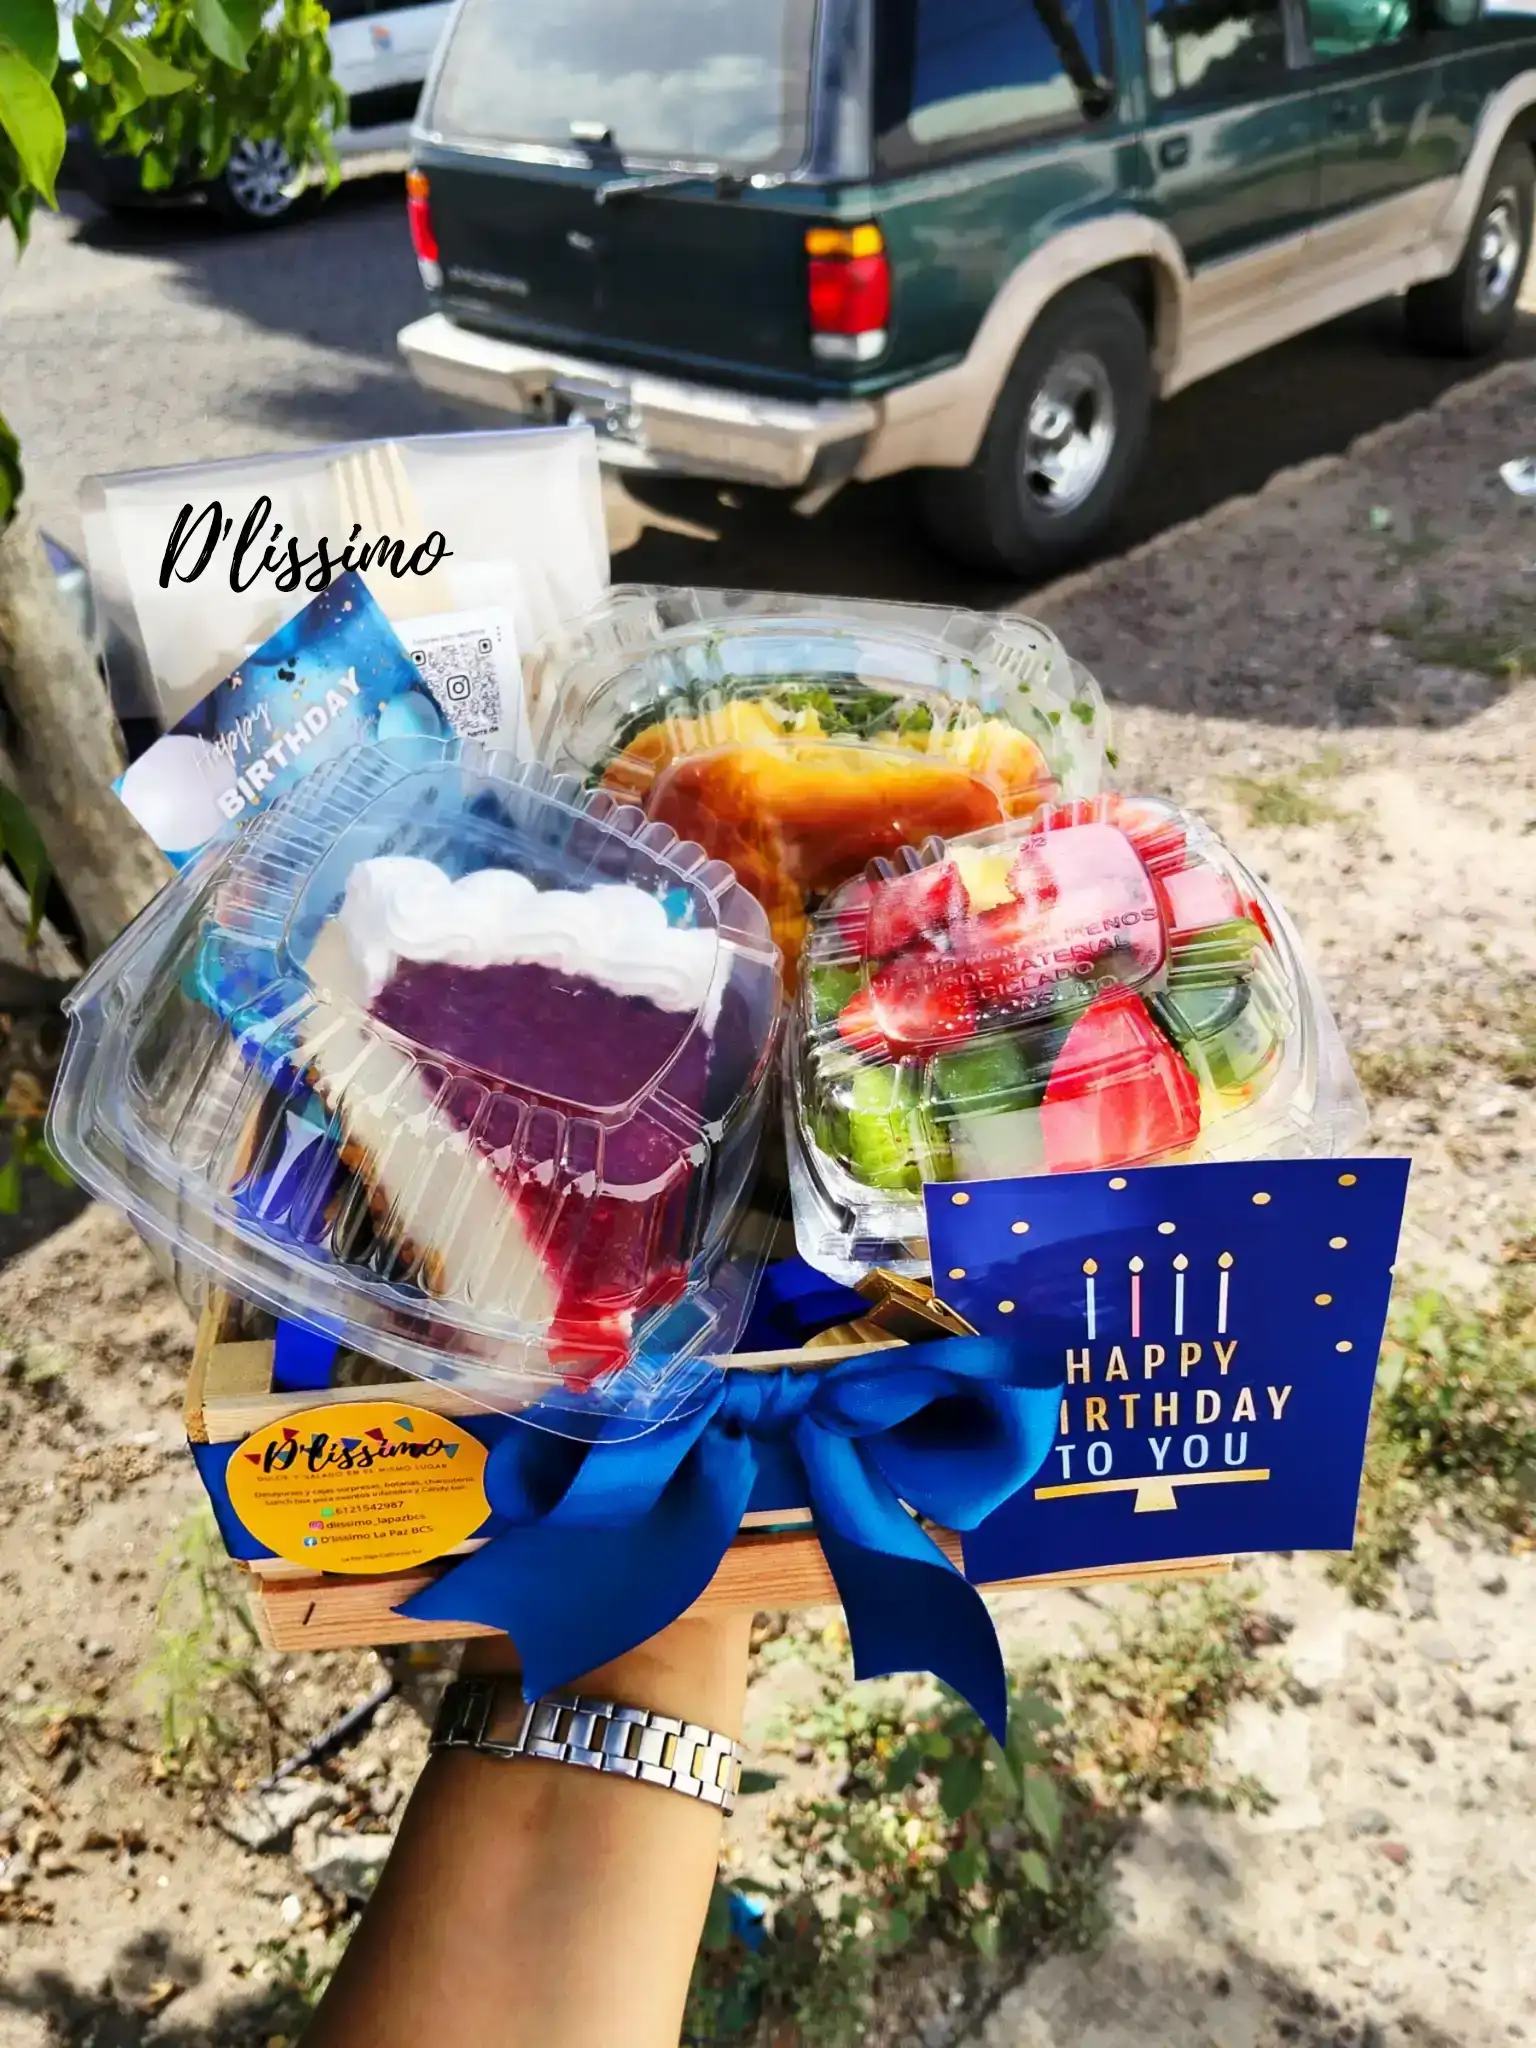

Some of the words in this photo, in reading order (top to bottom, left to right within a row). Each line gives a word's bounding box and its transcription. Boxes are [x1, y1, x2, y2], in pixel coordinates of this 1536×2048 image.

[193, 699, 271, 778] Happy
[216, 665, 361, 822] BIRTHDAY
[1066, 1339, 1239, 1385] HAPPY
[1060, 1385, 1293, 1435] IRTHDAY
[1055, 1440, 1113, 1480] TO
[1148, 1431, 1249, 1471] YOU
[334, 1500, 405, 1516] 6121542987
[373, 1530, 387, 1539] La
[390, 1527, 409, 1537] Paz
[411, 1524, 434, 1535] BCS
